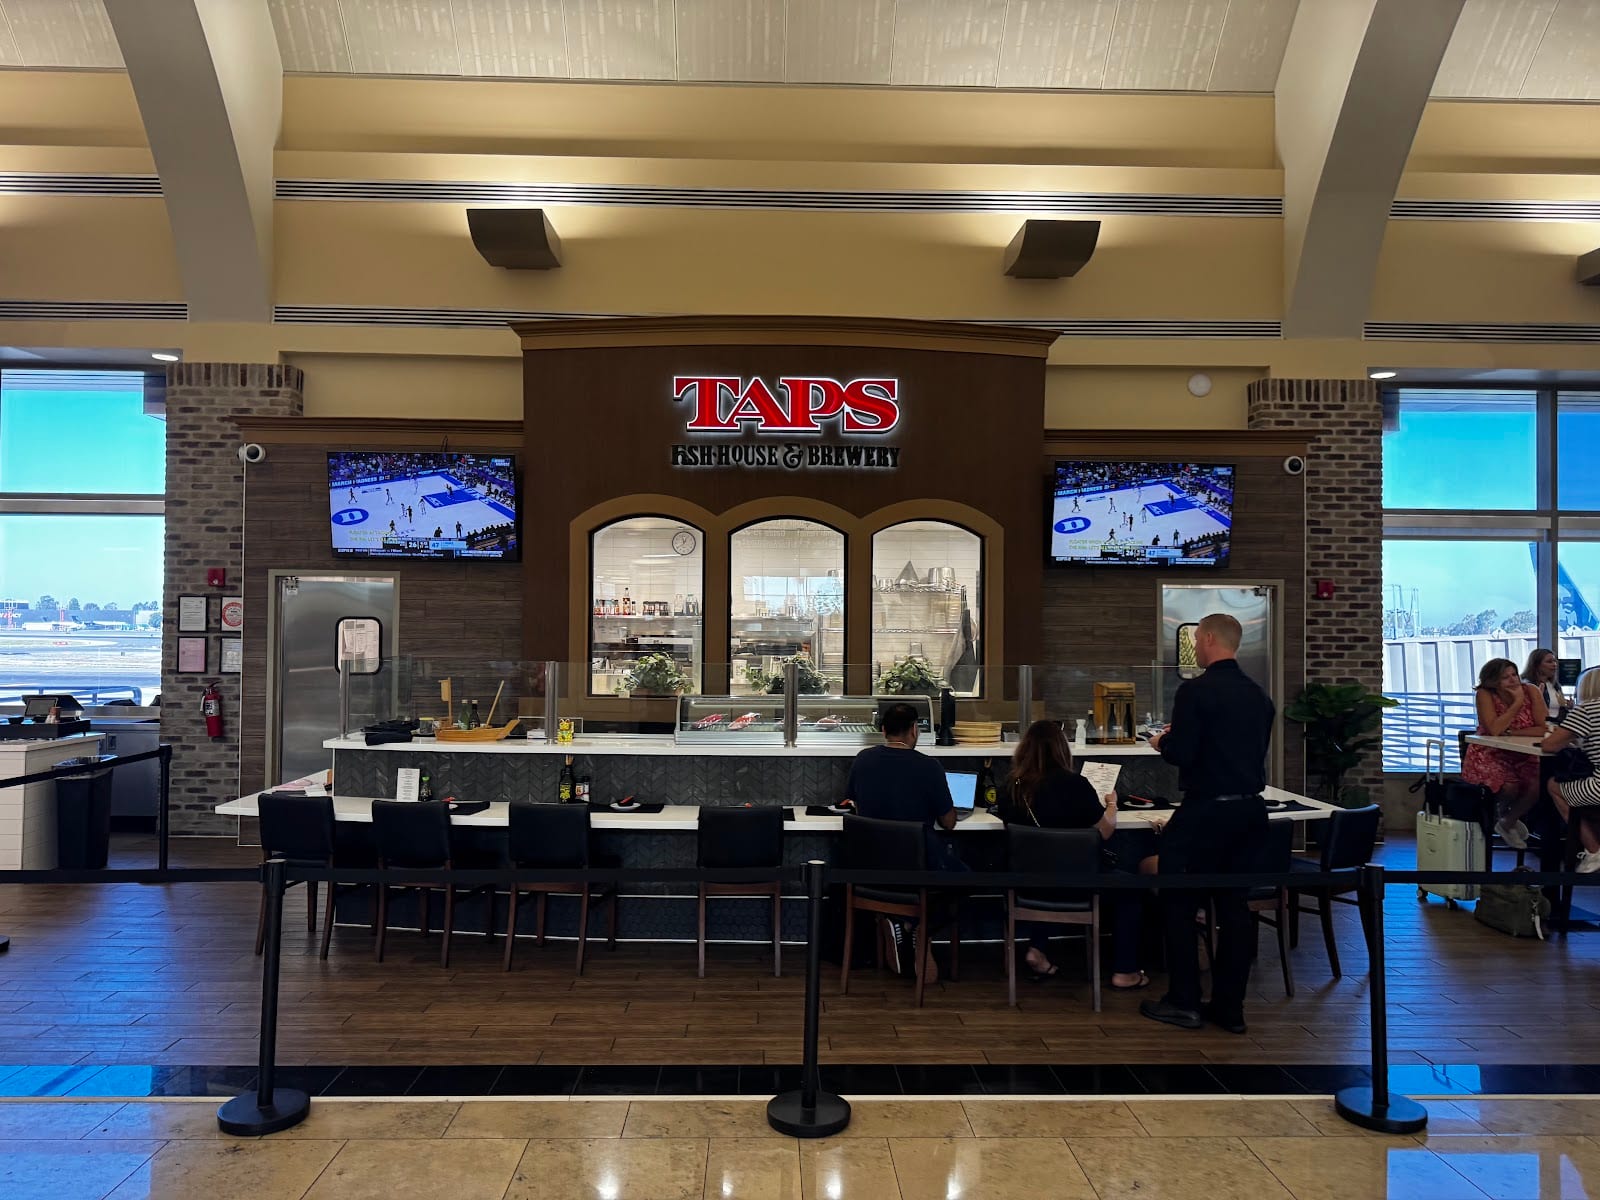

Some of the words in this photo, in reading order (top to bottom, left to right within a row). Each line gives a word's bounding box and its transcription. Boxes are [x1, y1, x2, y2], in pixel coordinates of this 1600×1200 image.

[673, 376, 900, 432] TAPS
[782, 442, 803, 469] &
[807, 445, 901, 468] BREWERY
